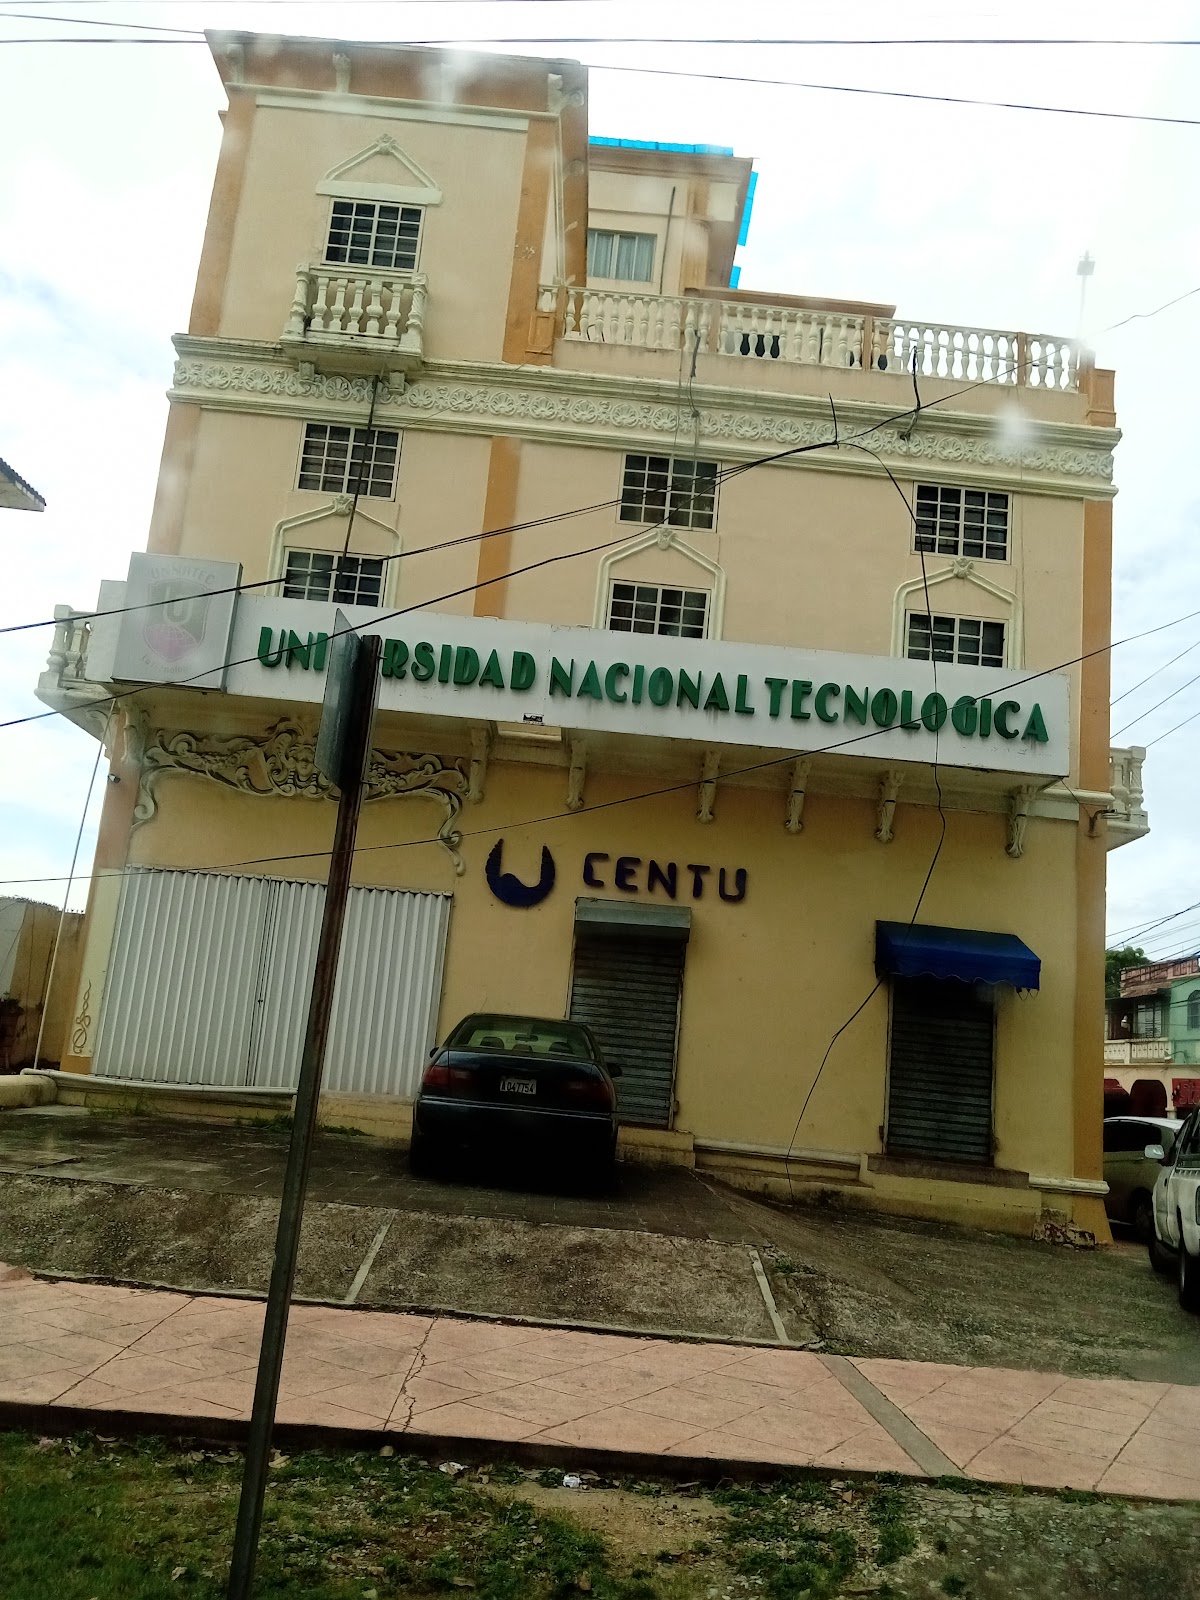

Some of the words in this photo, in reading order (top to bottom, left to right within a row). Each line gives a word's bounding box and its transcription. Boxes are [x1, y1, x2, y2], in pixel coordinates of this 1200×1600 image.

[257, 626, 537, 690] UNIRSIDAD
[548, 656, 755, 714] NACIONAL
[764, 676, 1050, 742] TECNOLOGICA
[582, 852, 747, 902] CENTU
